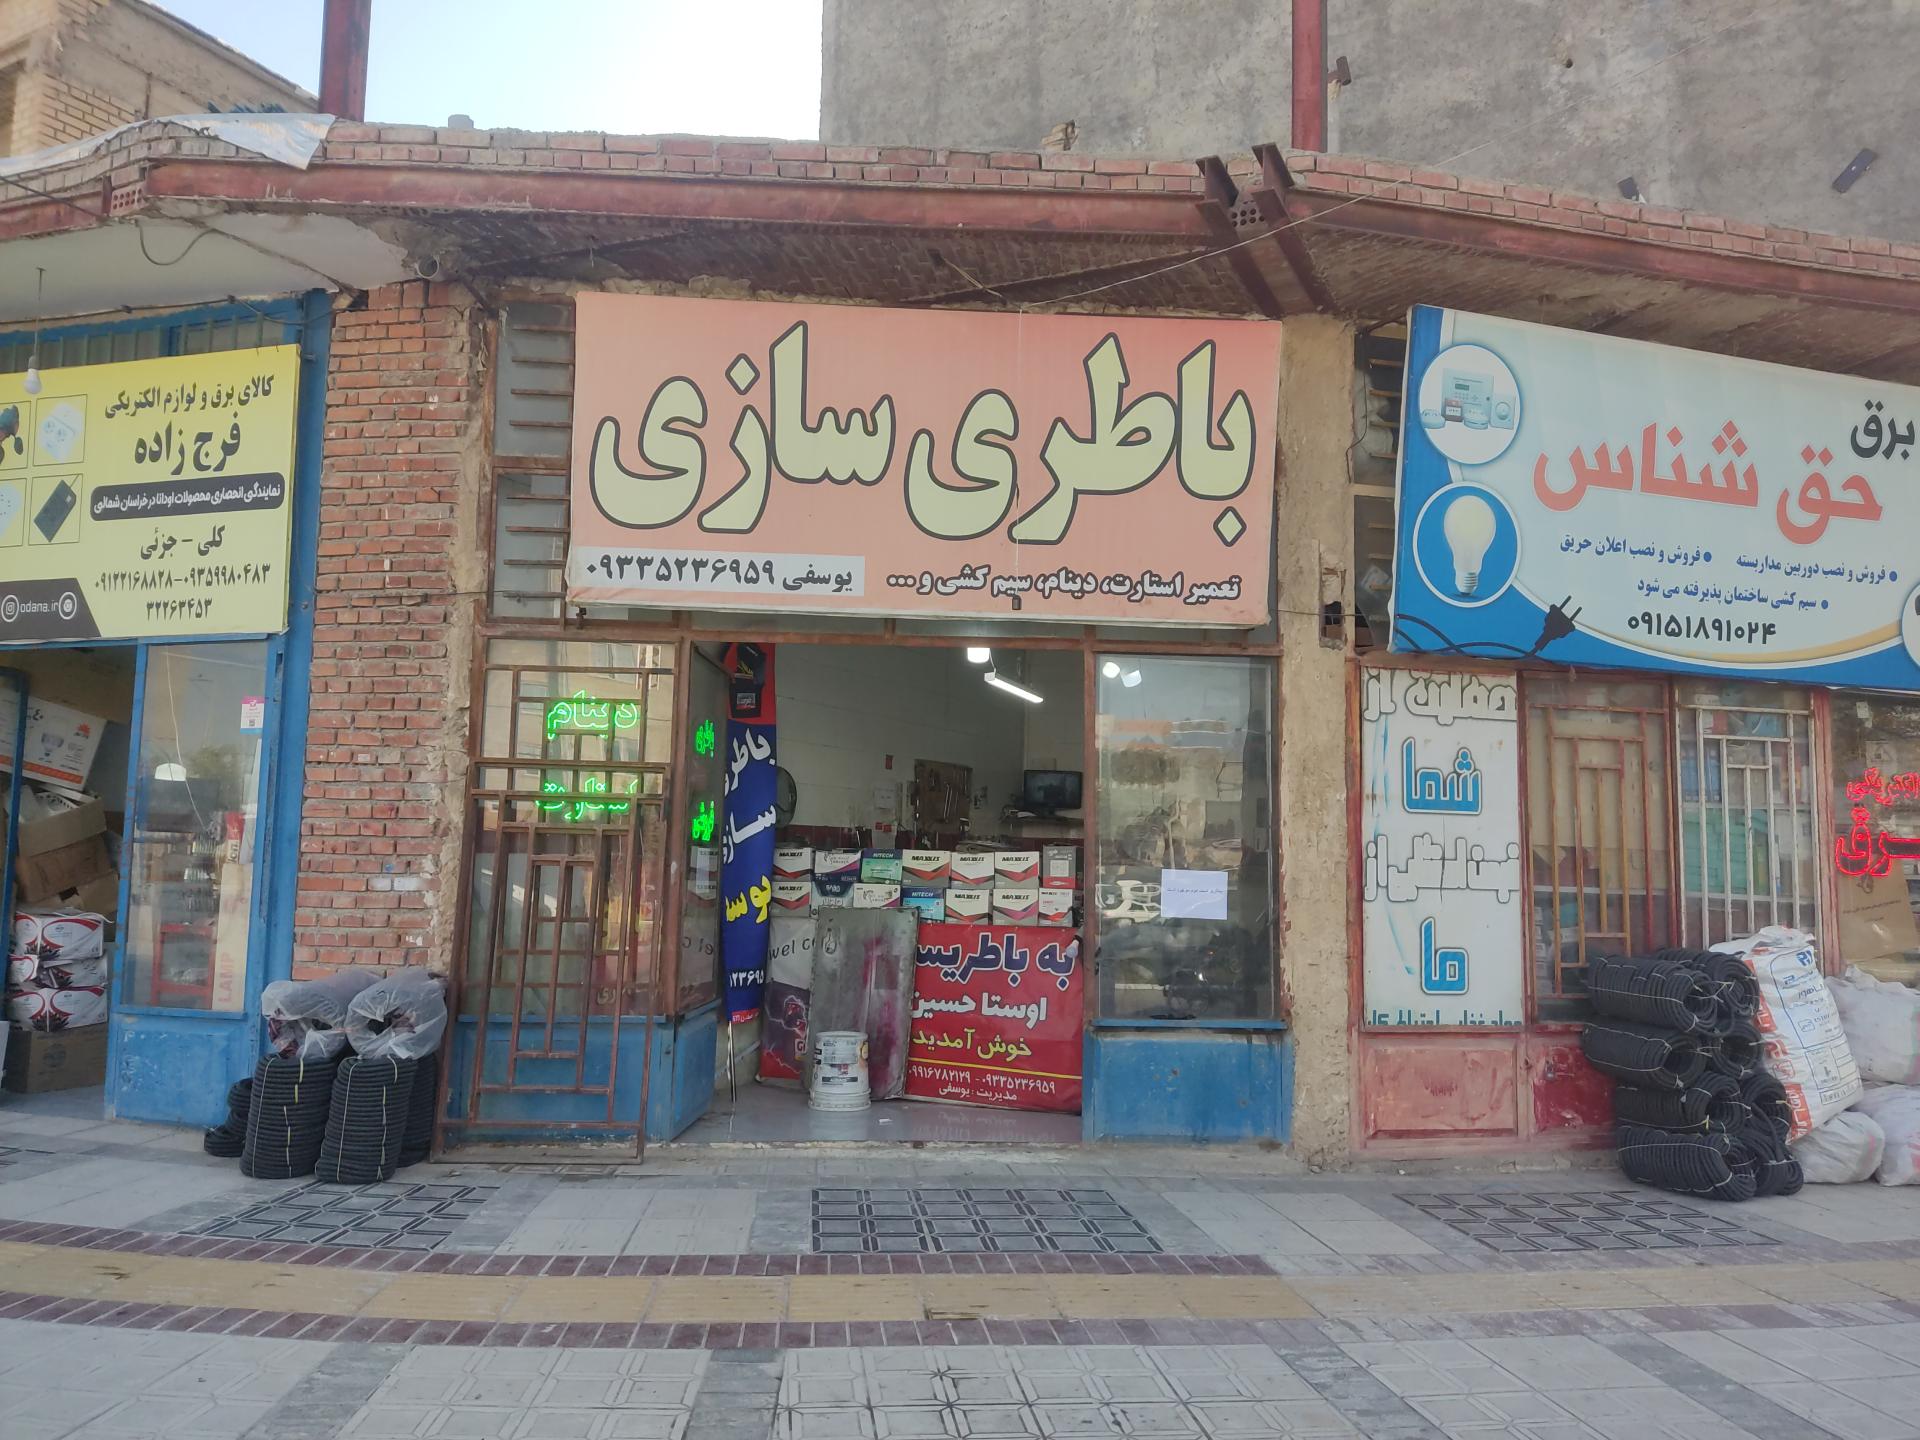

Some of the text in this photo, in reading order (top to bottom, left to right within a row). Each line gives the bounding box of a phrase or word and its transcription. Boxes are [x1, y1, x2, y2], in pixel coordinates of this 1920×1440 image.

[105, 374, 274, 418] کالای برق و لوازم الکتریکی
[134, 411, 241, 475] فرج زاده
[589, 320, 1255, 545] باطری سازی
[1849, 399, 1916, 460] برق
[93, 481, 281, 514] نمایندگی انحصاری محصولات اودانا در خراسان شمالی
[1532, 419, 1884, 546] حق شناس
[140, 527, 177, 560] جزئی
[198, 525, 226, 557] کلی
[1559, 534, 1701, 564] فروش و نصب اعلان حریق
[586, 554, 853, 593] یوسفی ۰۹۳۳۵۲۳۶۹۵۹
[936, 563, 990, 597] کشی
[991, 570, 1033, 598] سیم
[1035, 567, 1096, 599] دینام،
[1101, 570, 1184, 602] استارت،
[1784, 562, 1820, 580] دوربین
[1821, 563, 1845, 579] نصب
[1848, 570, 1853, 583] و
[1855, 568, 1886, 585] فروش
[20, 595, 58, 613] odana.ir
[1183, 576, 1242, 604] تعمیر
[1637, 577, 1817, 611] سیم کشی ساختمان پذیرفته می شود
[146, 598, 212, 621] ۳۲۲۶۳۴۵۳
[1627, 611, 1777, 645] ۰۹۱۵۱۸۹۱۰۲۴
[548, 690, 637, 740] دینام
[724, 728, 775, 796] باطر
[1402, 737, 1483, 815] شما
[916, 932, 1076, 991] به باطریس
[1420, 916, 1470, 995] ما
[912, 991, 1048, 1029] اوستا حسین
[912, 1028, 1032, 1062] خوش آمدید
[939, 1084, 970, 1098] یوسفی
